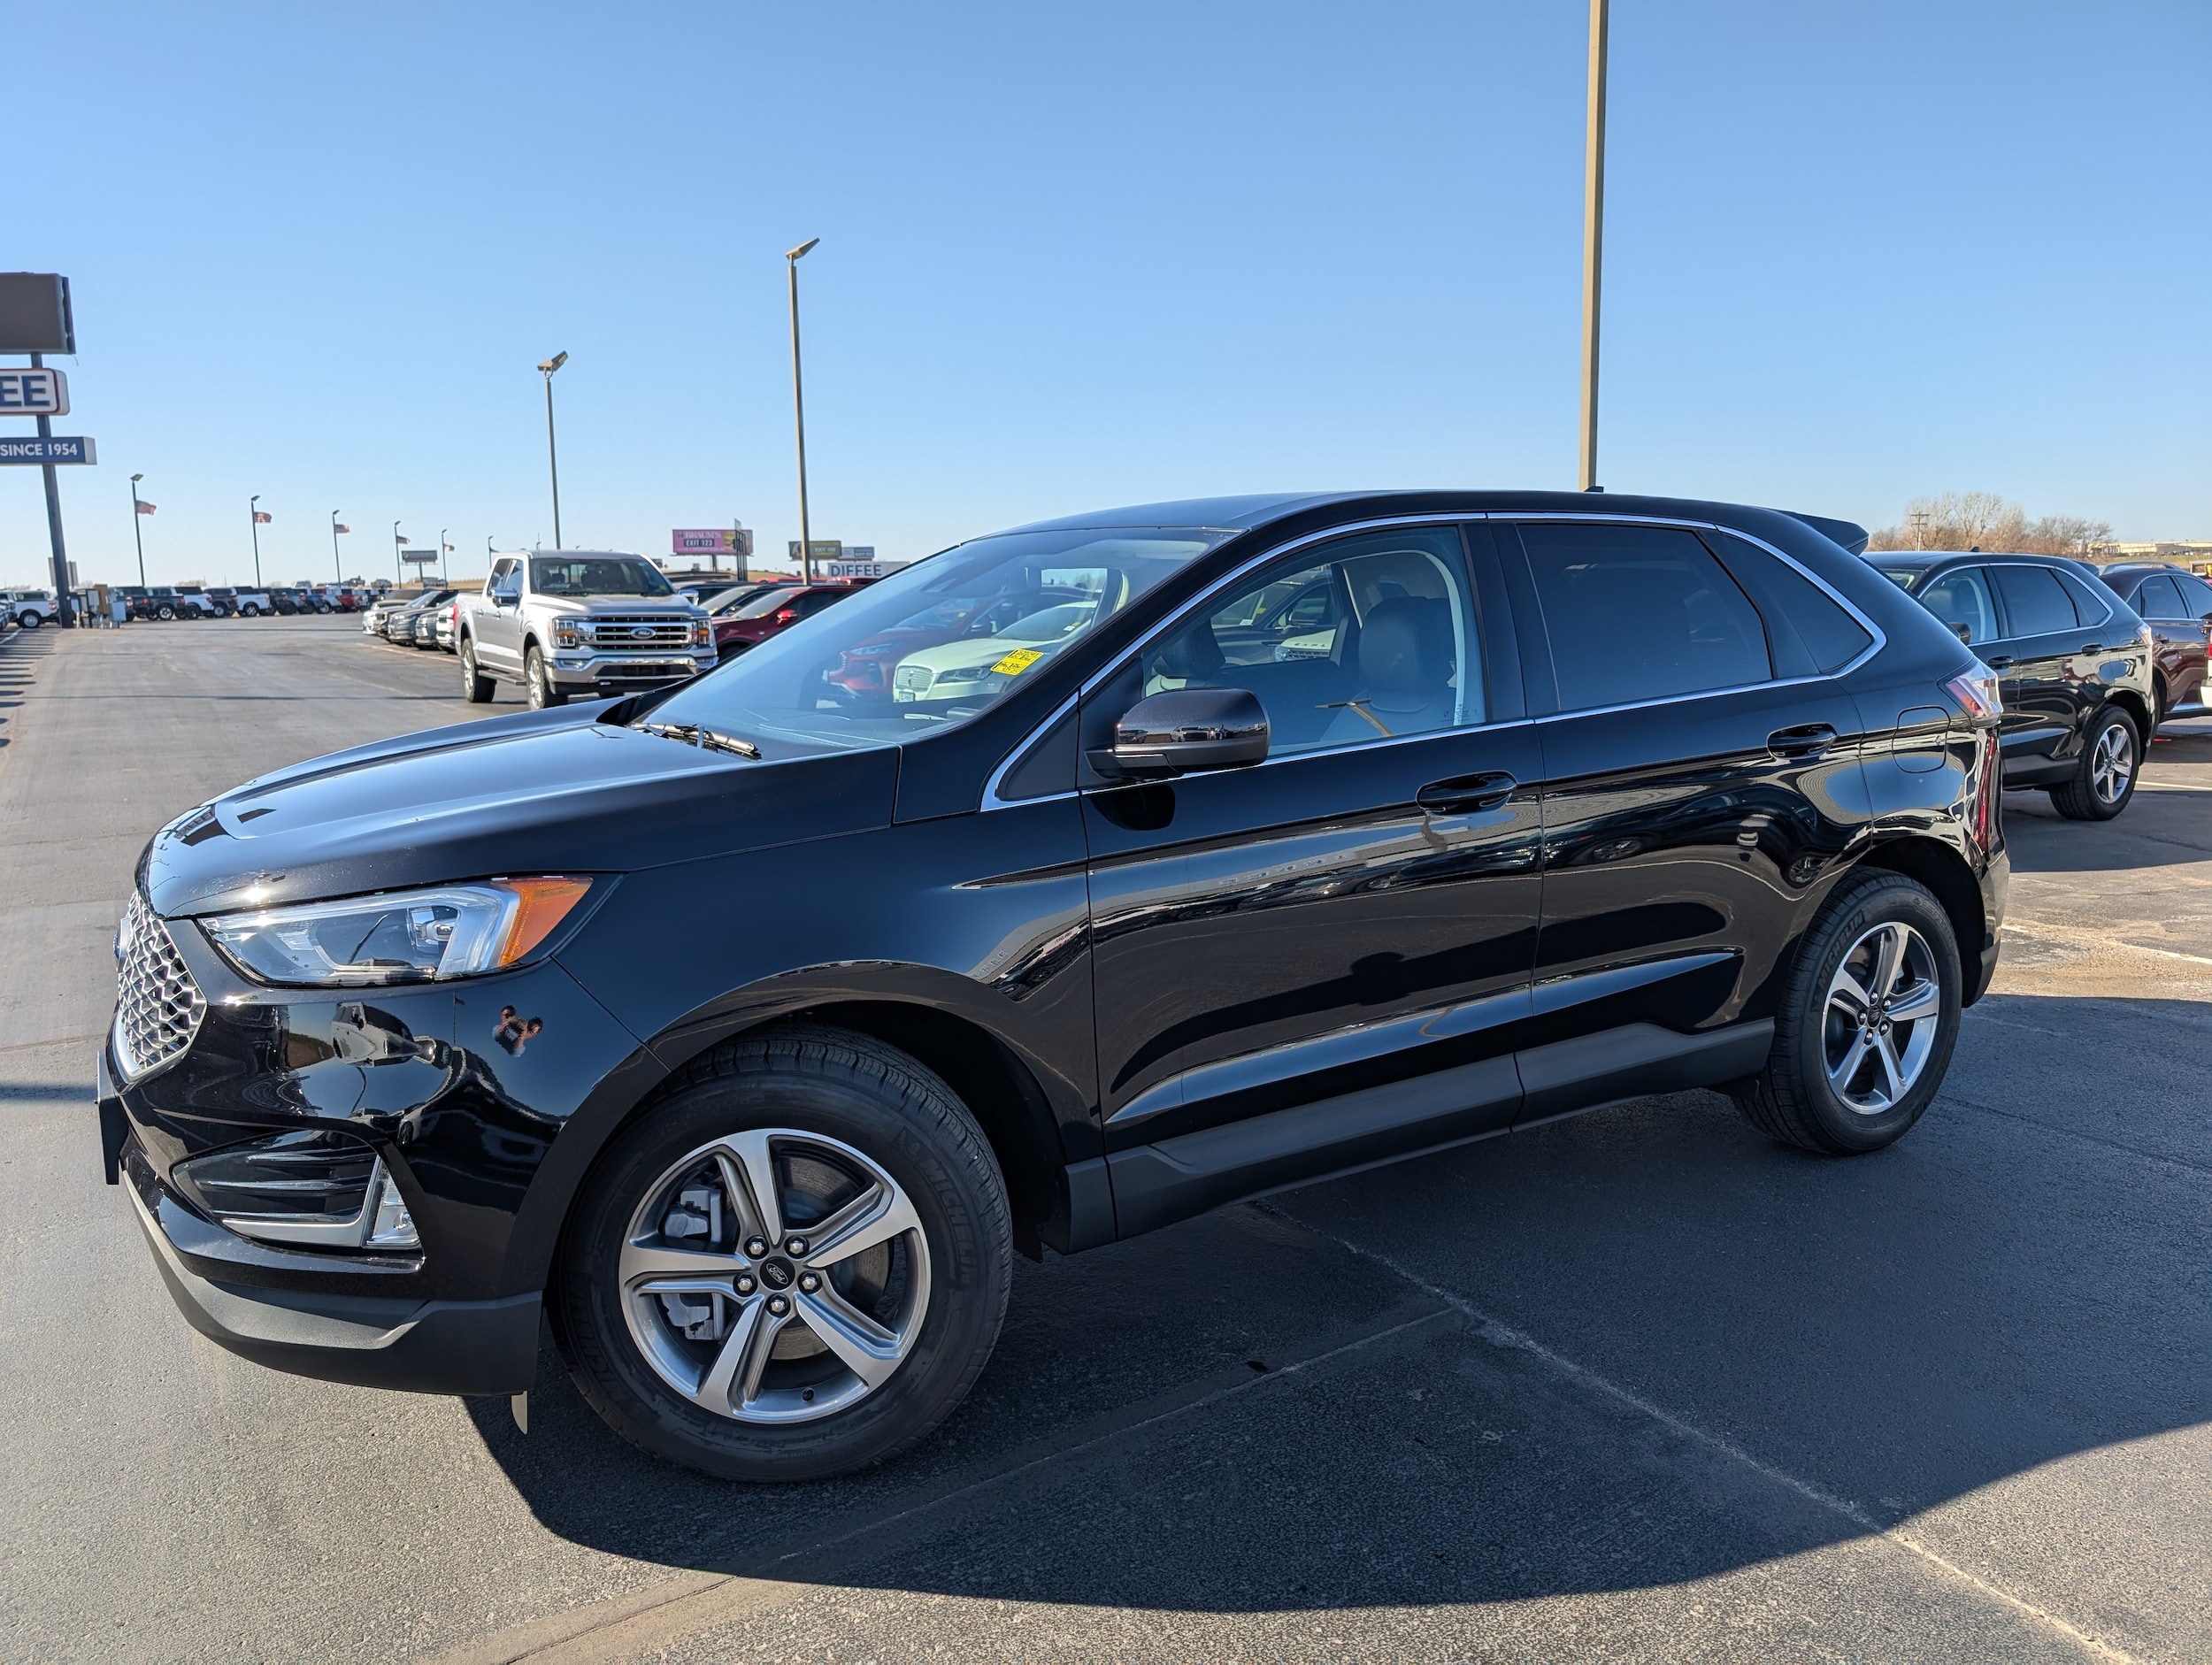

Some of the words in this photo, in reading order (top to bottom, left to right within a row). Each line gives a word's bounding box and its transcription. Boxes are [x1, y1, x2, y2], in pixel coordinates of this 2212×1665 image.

[0, 443, 43, 457] SINCE
[47, 443, 78, 457] 1954
[831, 564, 882, 577] DIFFEE
[1816, 911, 1864, 990] MICHELIN
[918, 1155, 977, 1285] MICHELIN
[768, 1266, 786, 1282] Ford
